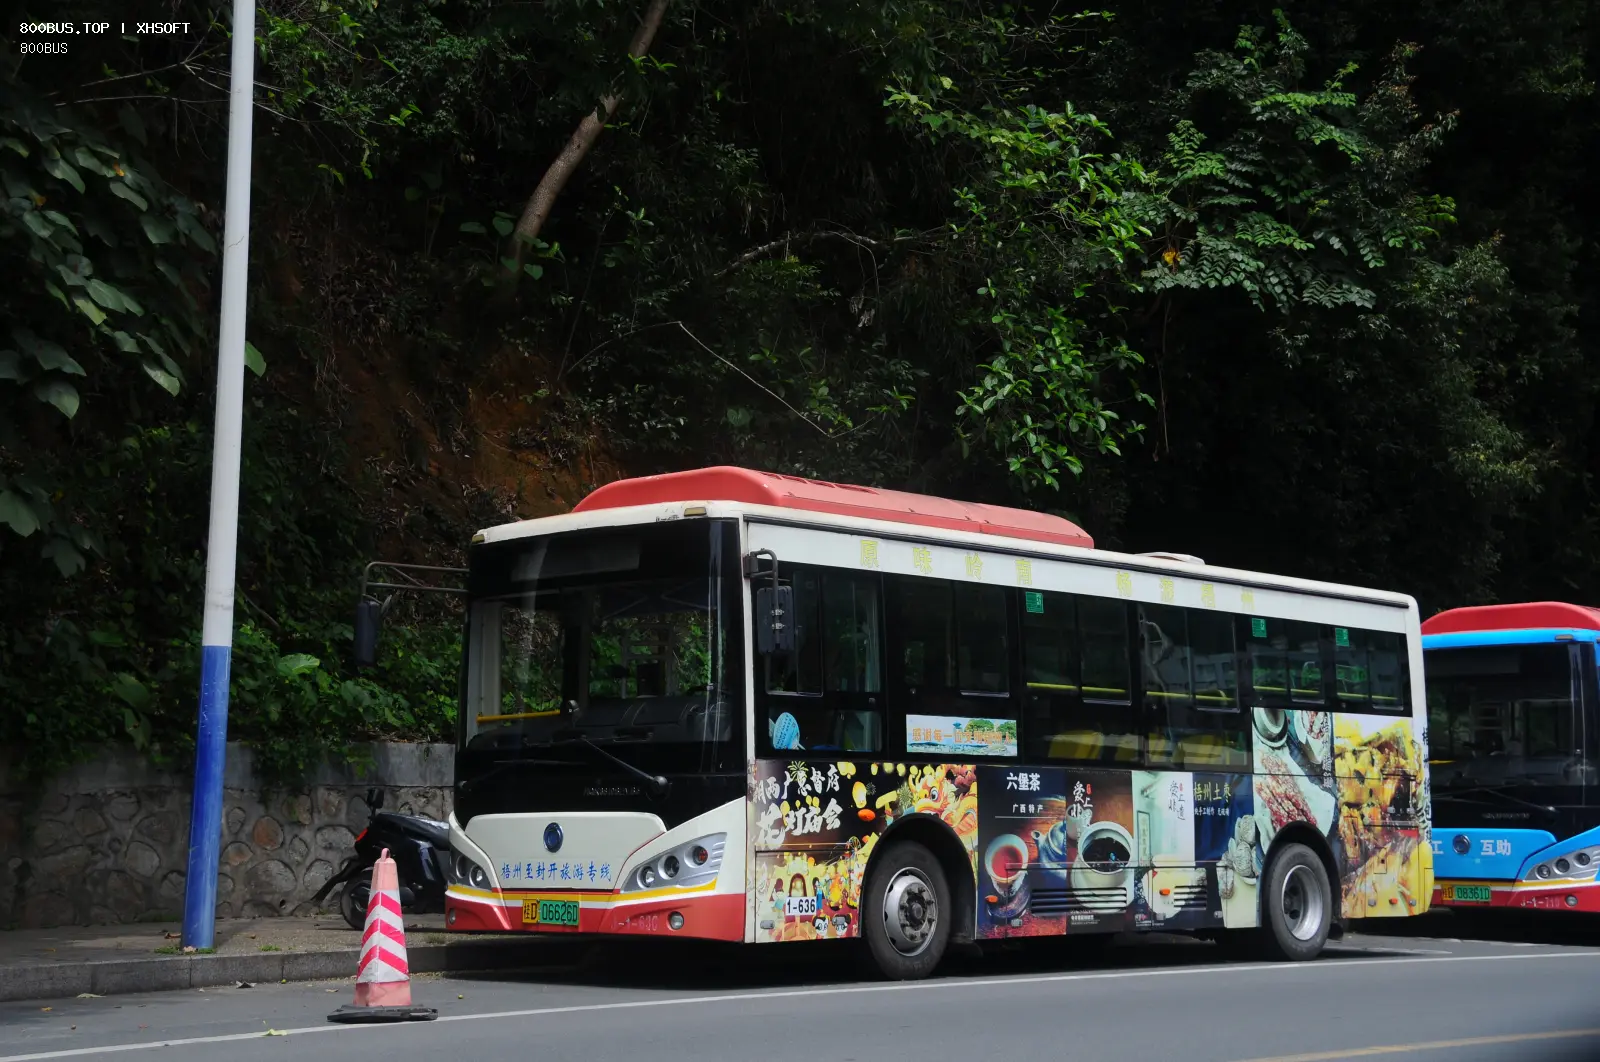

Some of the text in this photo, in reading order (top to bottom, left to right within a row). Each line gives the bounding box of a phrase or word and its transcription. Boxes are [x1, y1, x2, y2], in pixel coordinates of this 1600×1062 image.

[1006, 772, 1040, 791] 六堡茶
[1012, 803, 1043, 814] 广西特产
[1480, 839, 1511, 856] 互助
[501, 861, 612, 883] 梧州至封开旅游专线
[786, 897, 817, 914] 1-636
